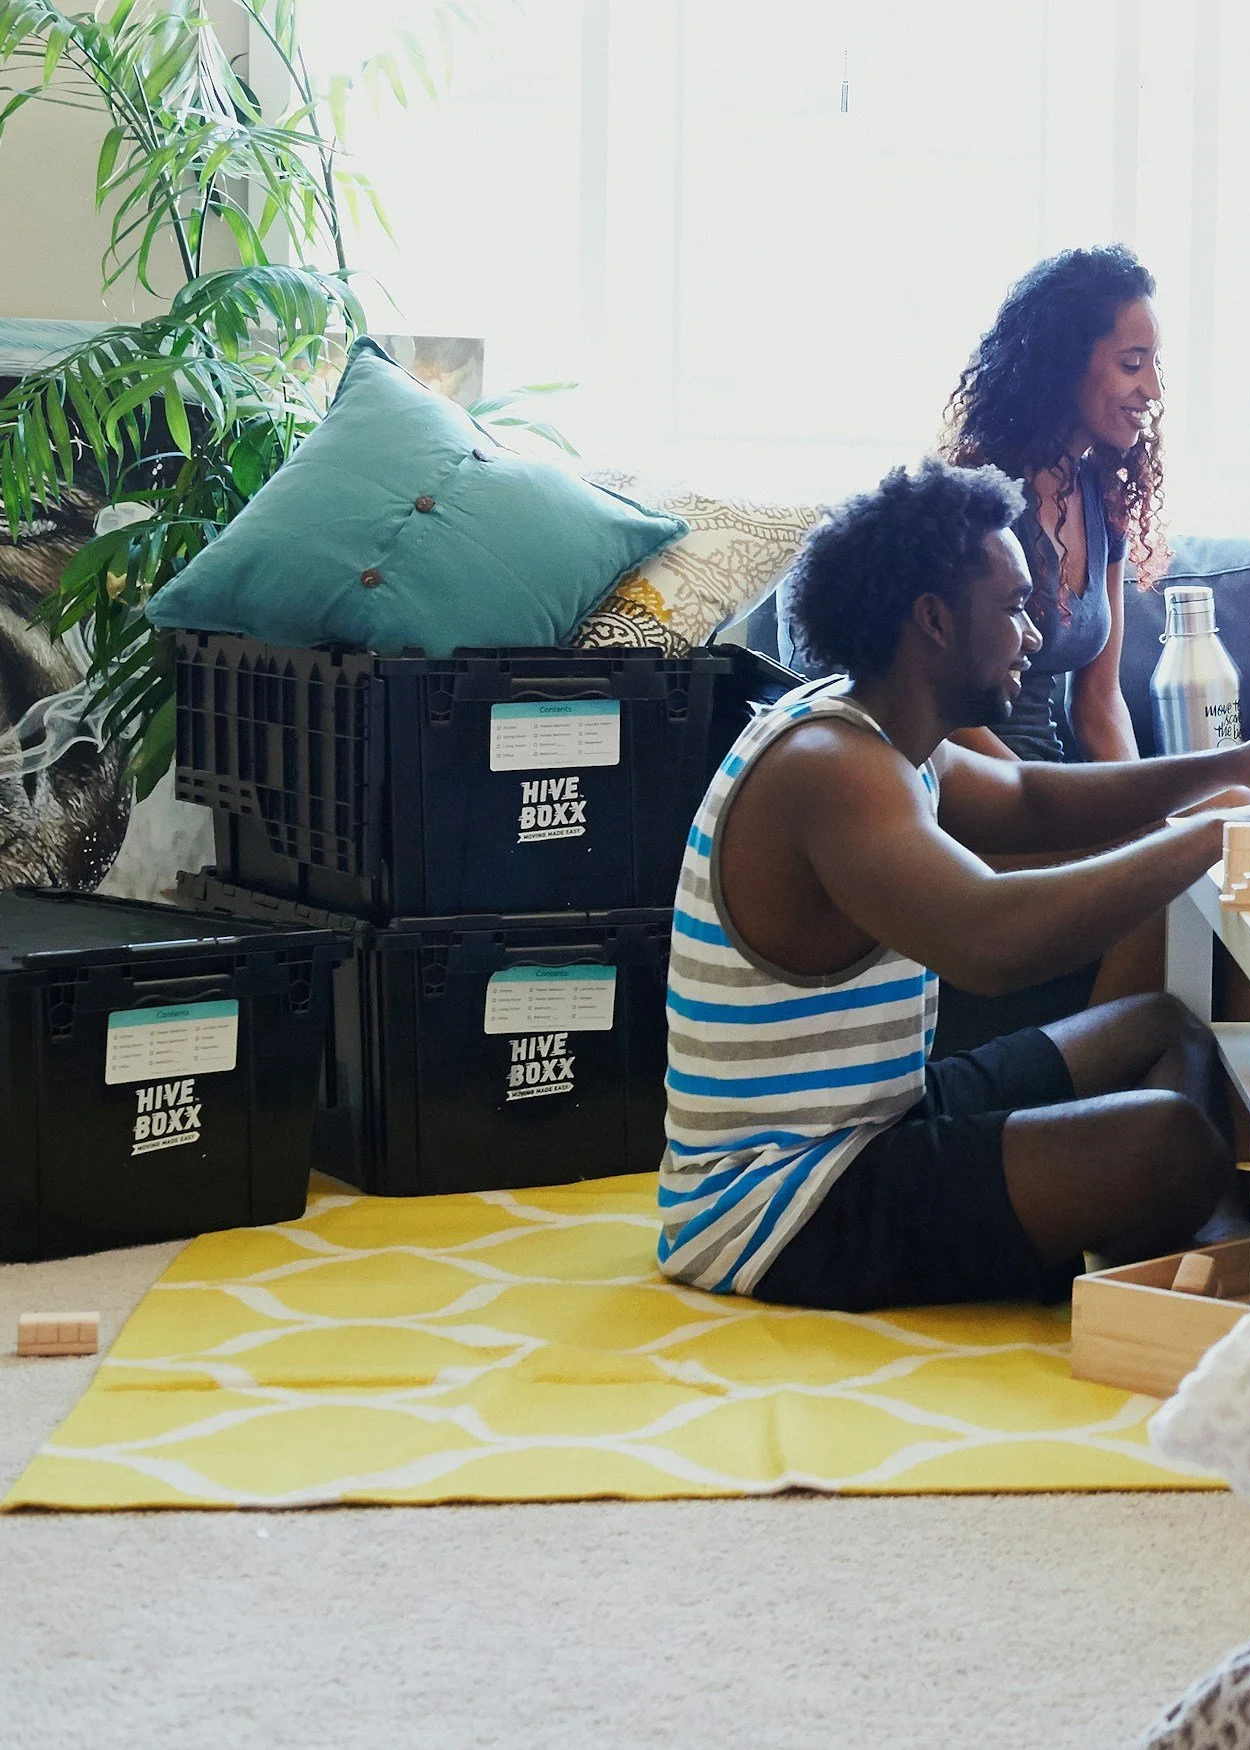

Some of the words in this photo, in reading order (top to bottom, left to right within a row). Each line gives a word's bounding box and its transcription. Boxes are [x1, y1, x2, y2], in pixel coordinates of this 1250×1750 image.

[539, 706, 573, 714] Contents
[1214, 721, 1232, 738] the
[520, 776, 580, 804] HIVE
[518, 800, 588, 830] BOXX
[523, 831, 546, 840] MOVING
[547, 829, 564, 838] MADE
[565, 828, 581, 836] EASY
[156, 1010, 190, 1019] Contents
[509, 1032, 569, 1062] HIVE
[506, 1056, 576, 1088] BOXX
[135, 1078, 195, 1114] HIVE
[535, 1086, 553, 1095] MADE
[554, 1084, 570, 1092] EASY
[133, 1103, 203, 1141] BOXX
[162, 1137, 179, 1146] MADE
